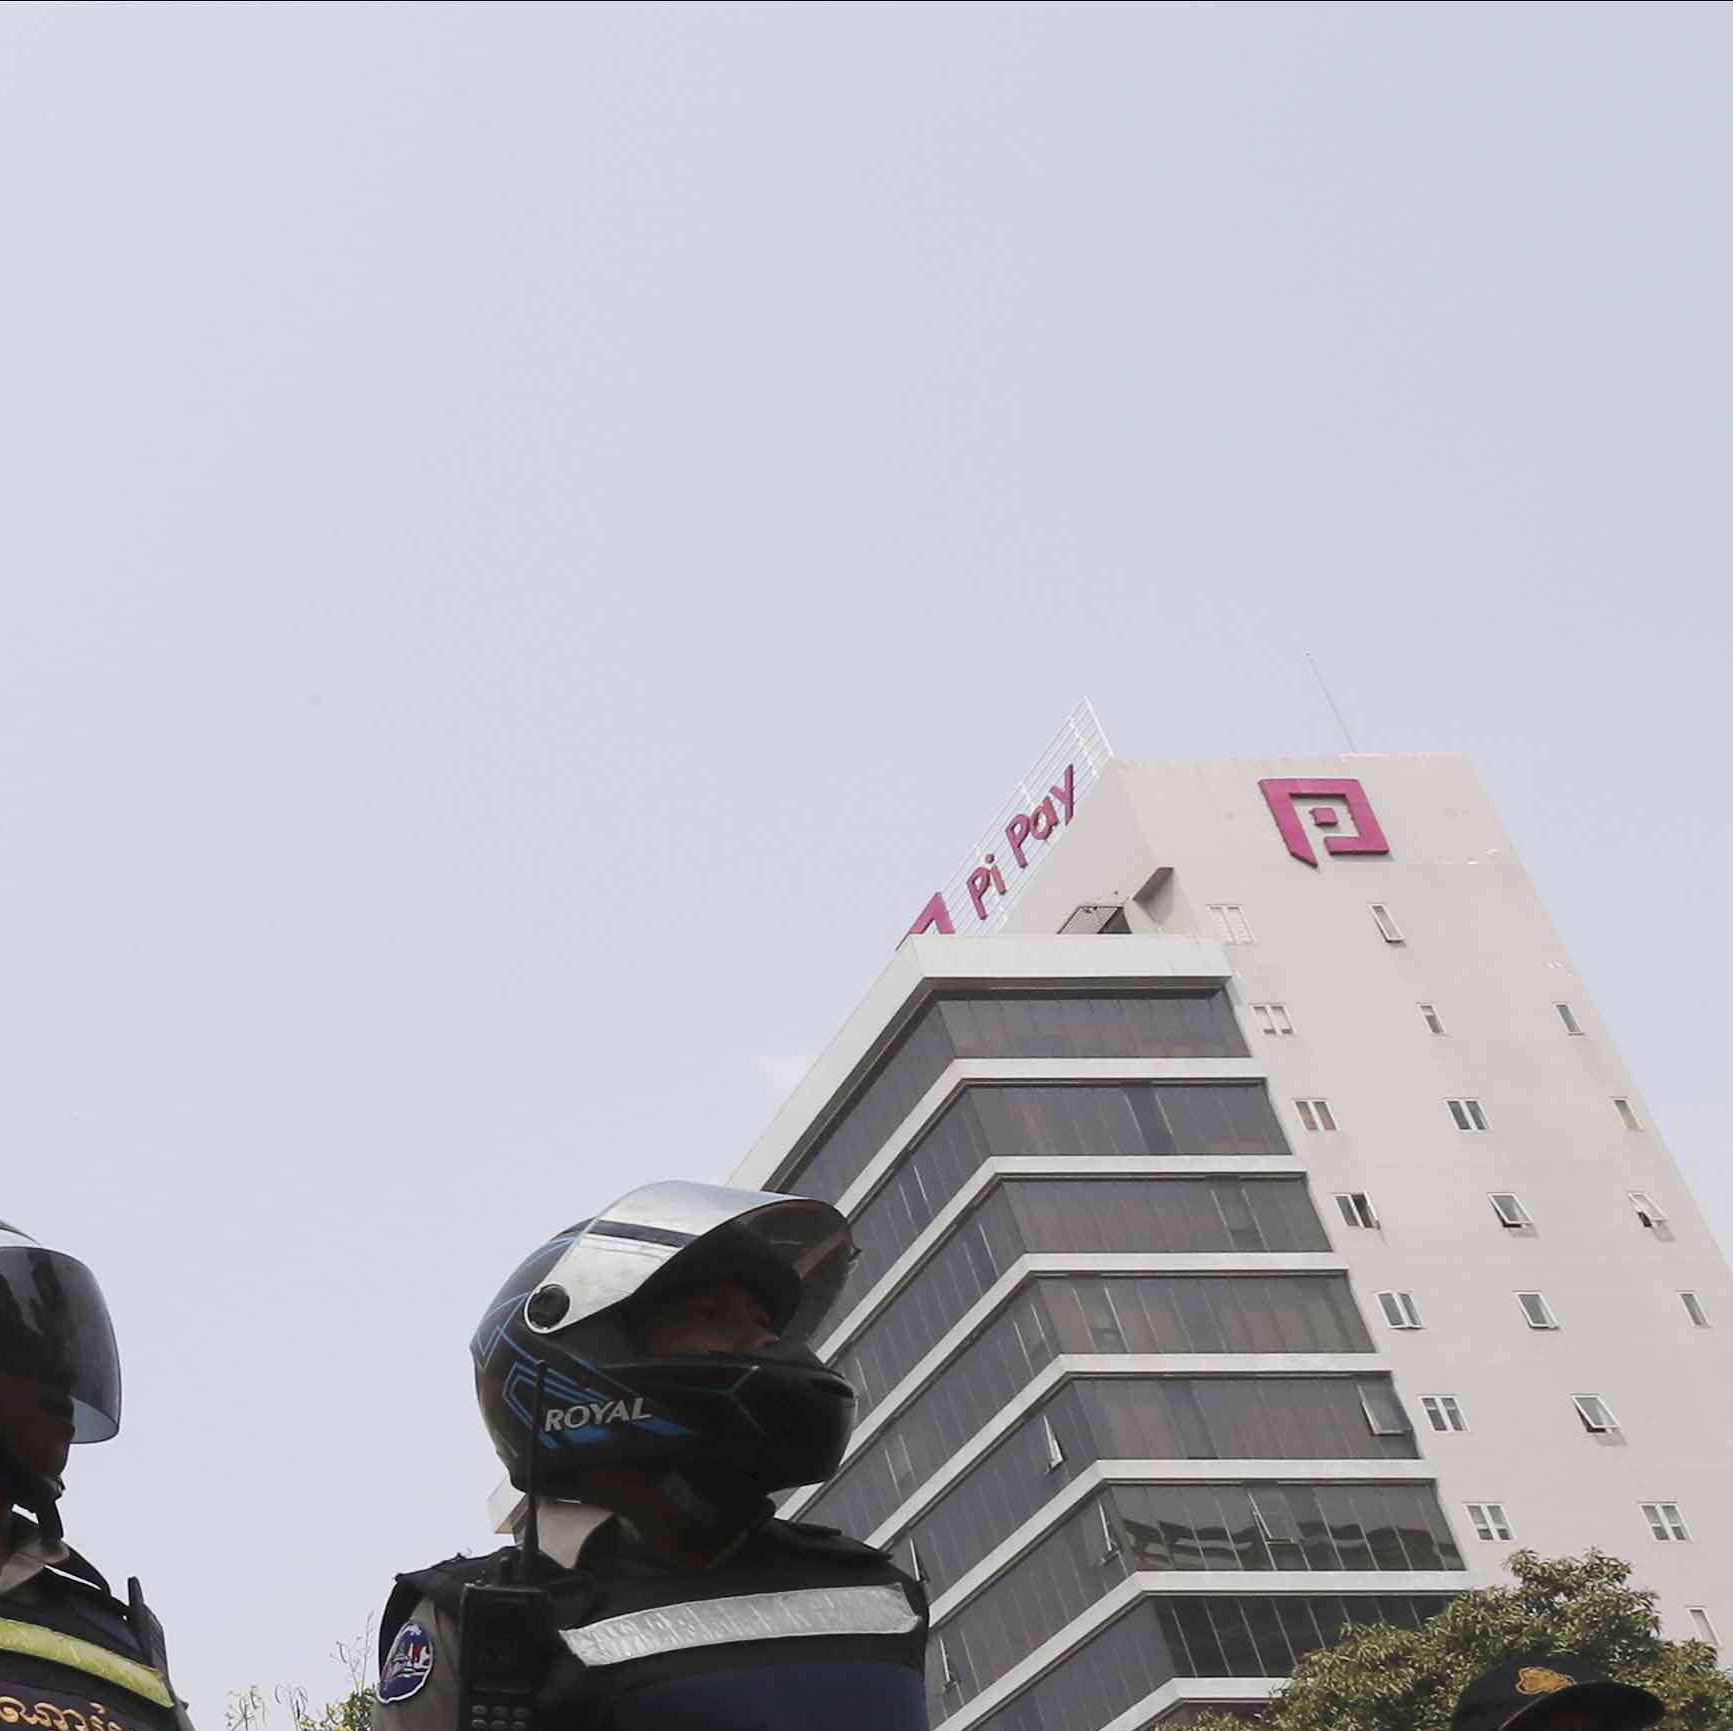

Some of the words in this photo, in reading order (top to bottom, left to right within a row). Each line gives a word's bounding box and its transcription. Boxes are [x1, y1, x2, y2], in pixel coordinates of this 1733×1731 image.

[966, 853, 1008, 920] Pi
[1005, 763, 1075, 869] Pay
[545, 1397, 653, 1432] ROYAL
